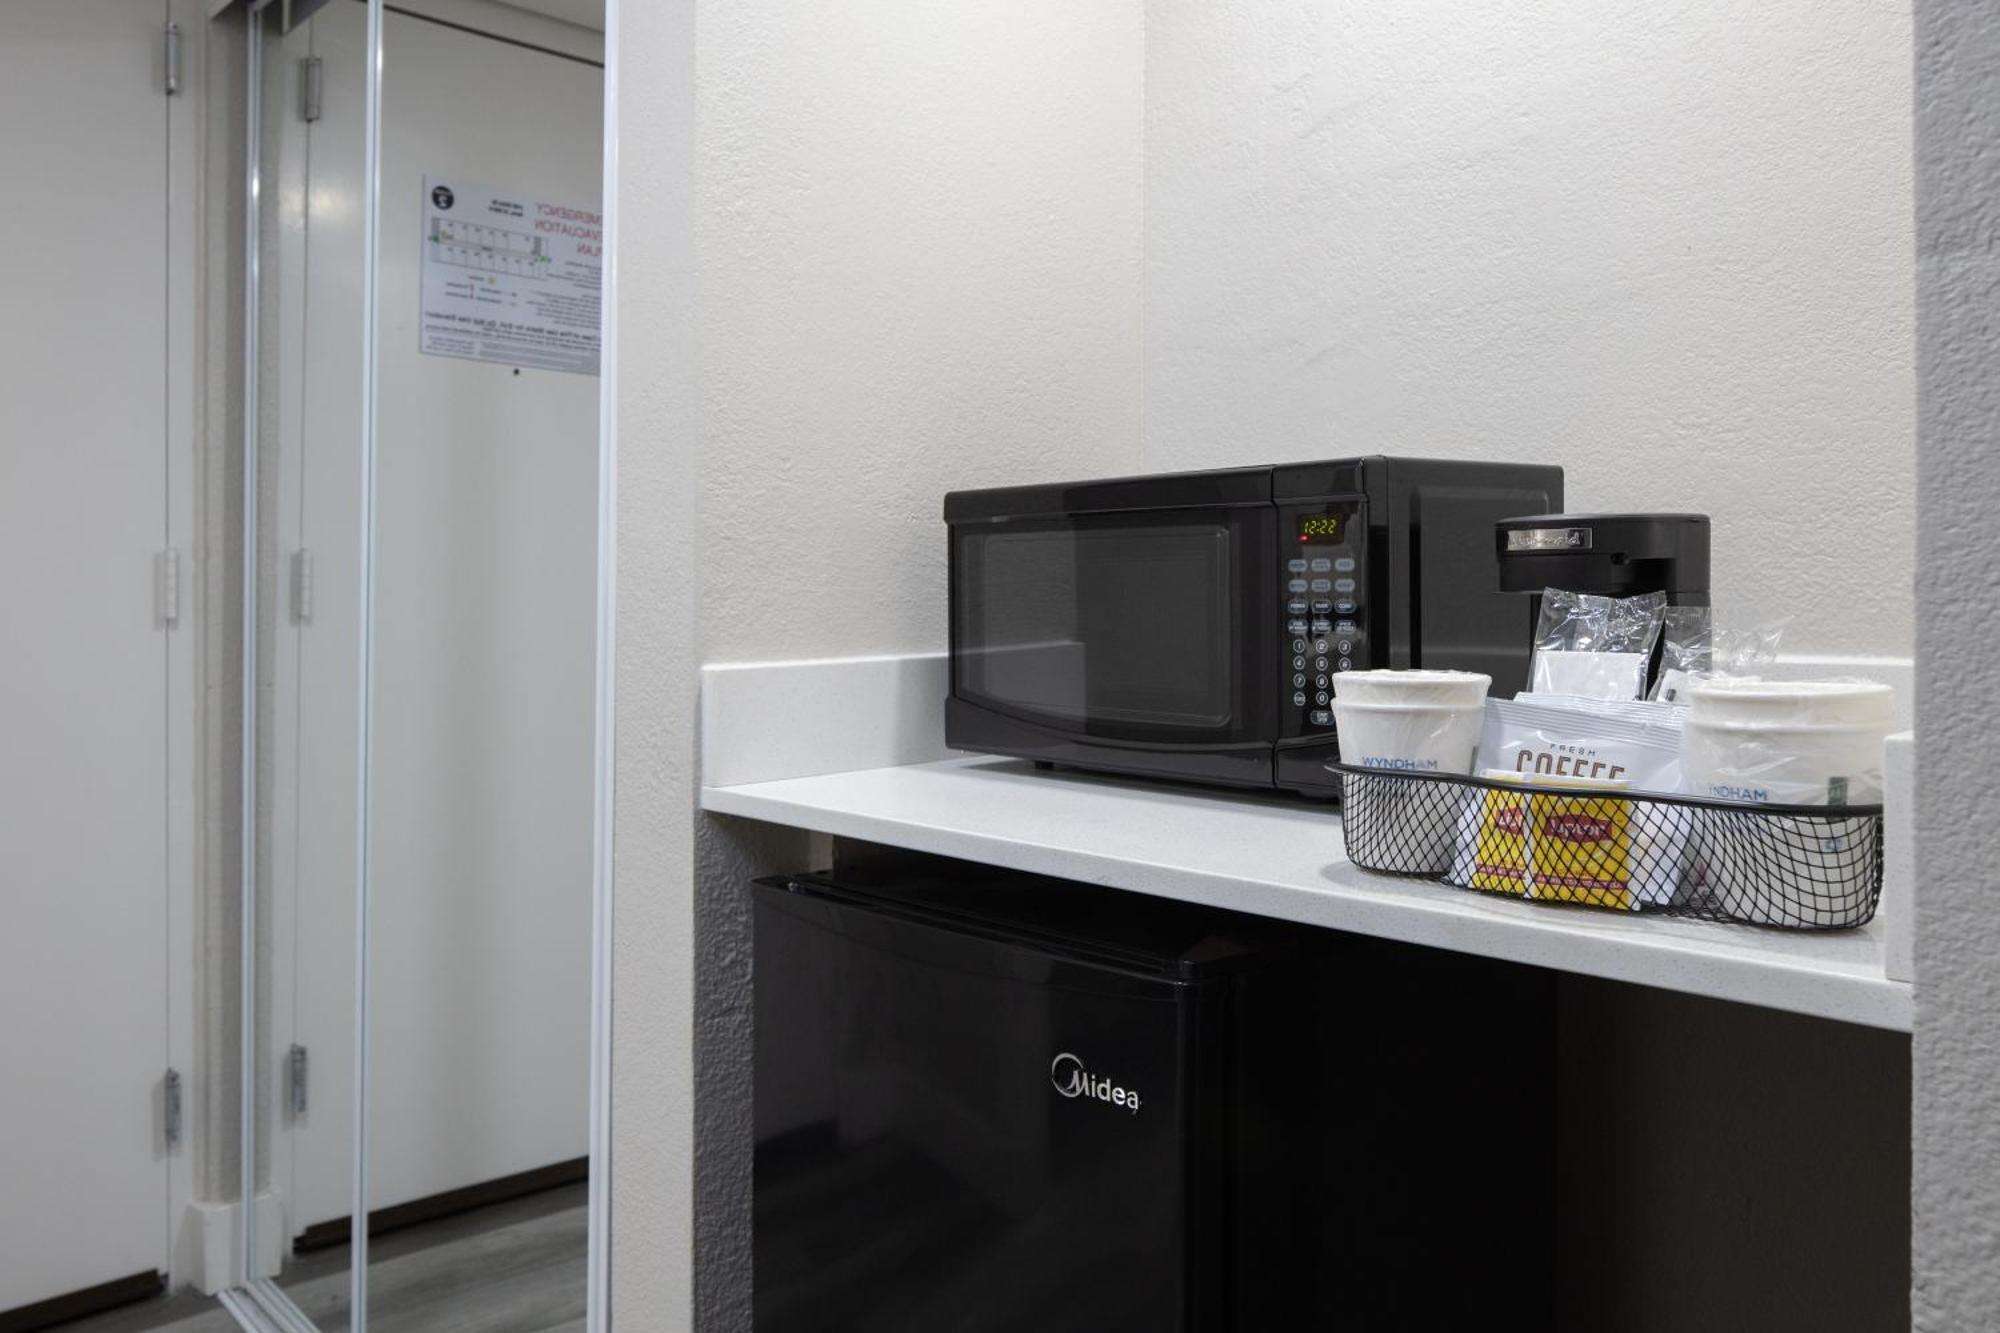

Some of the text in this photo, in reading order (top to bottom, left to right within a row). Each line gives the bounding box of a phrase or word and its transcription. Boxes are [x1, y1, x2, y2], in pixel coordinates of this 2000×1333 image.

[1303, 519, 1336, 534] 12:22
[1550, 743, 1596, 756] FRESH
[1361, 756, 1439, 770] WYNDHAM
[1516, 749, 1625, 779] COFFEE
[1708, 784, 1769, 801] NDHAM
[1060, 1062, 1138, 1110] Midea
